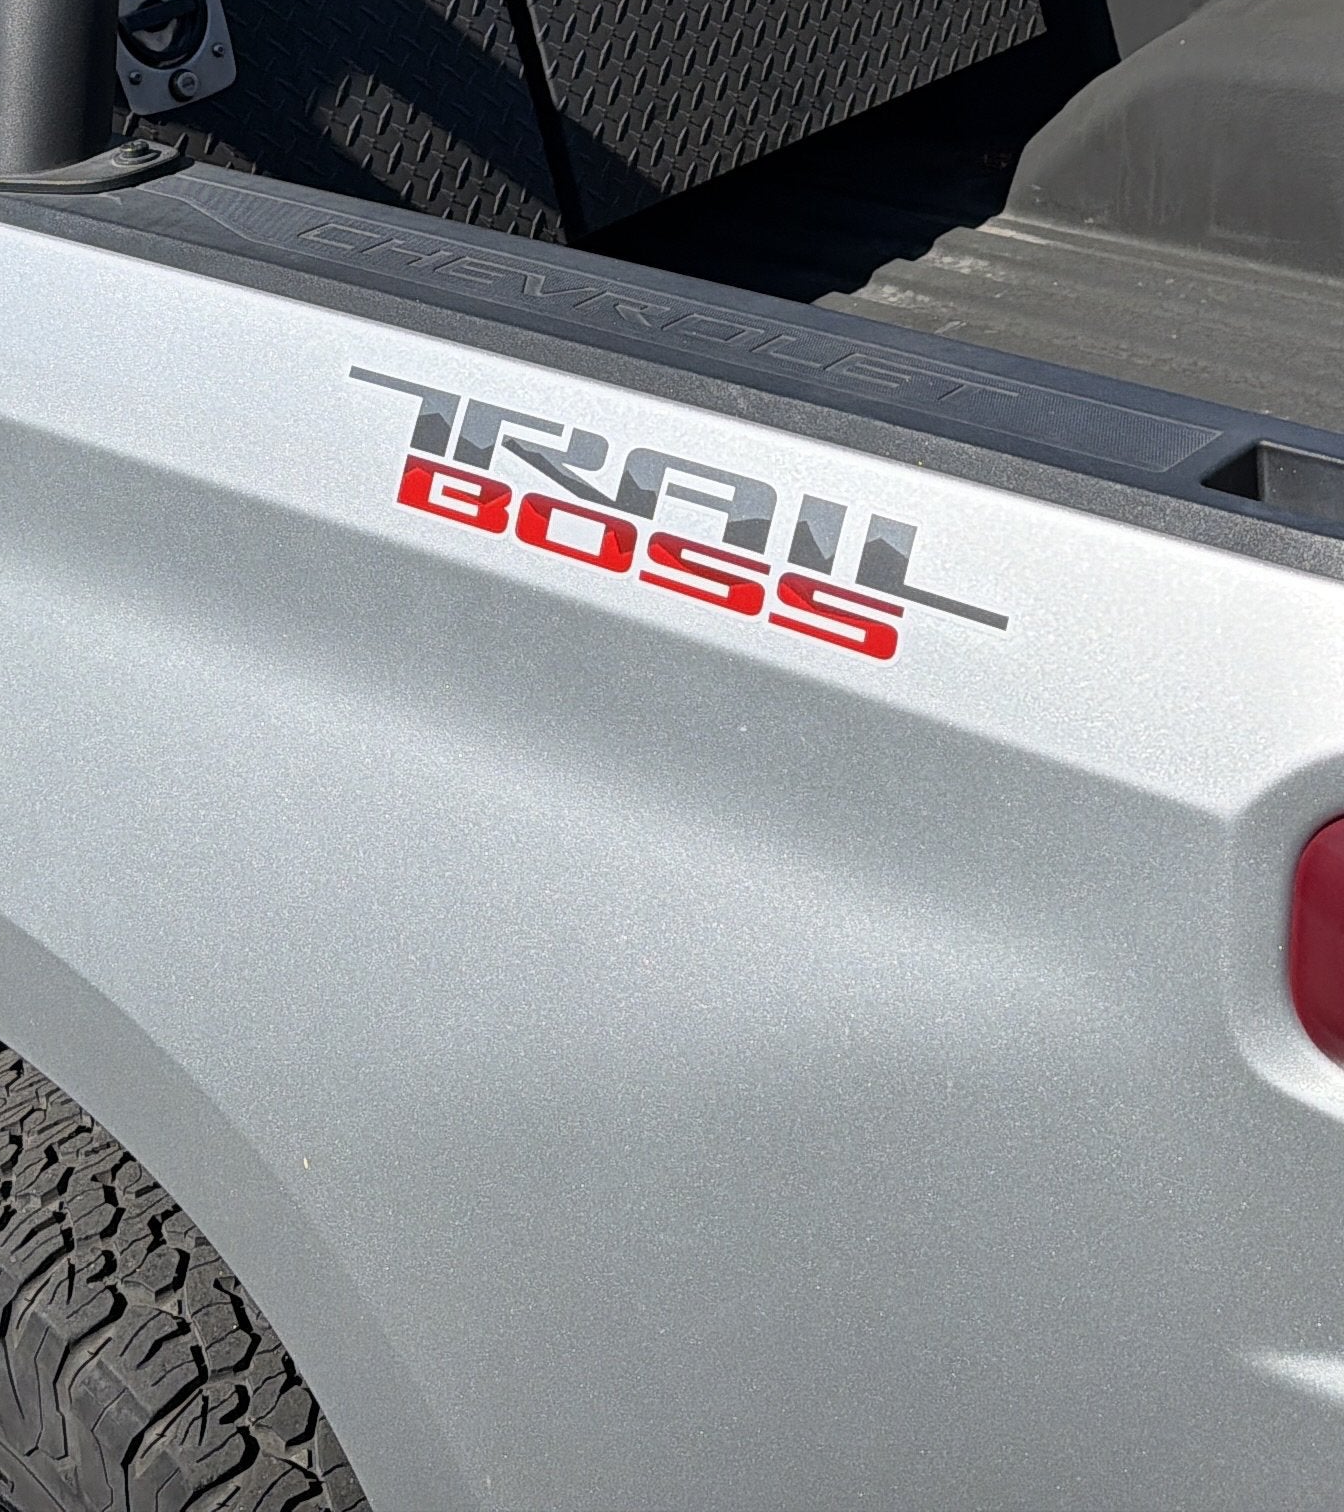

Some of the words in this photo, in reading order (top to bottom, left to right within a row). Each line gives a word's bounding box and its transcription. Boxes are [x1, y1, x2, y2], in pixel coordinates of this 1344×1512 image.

[295, 222, 1021, 403] CHEVROLET
[348, 365, 1009, 631] TRAIL
[396, 454, 905, 661] BOSS
